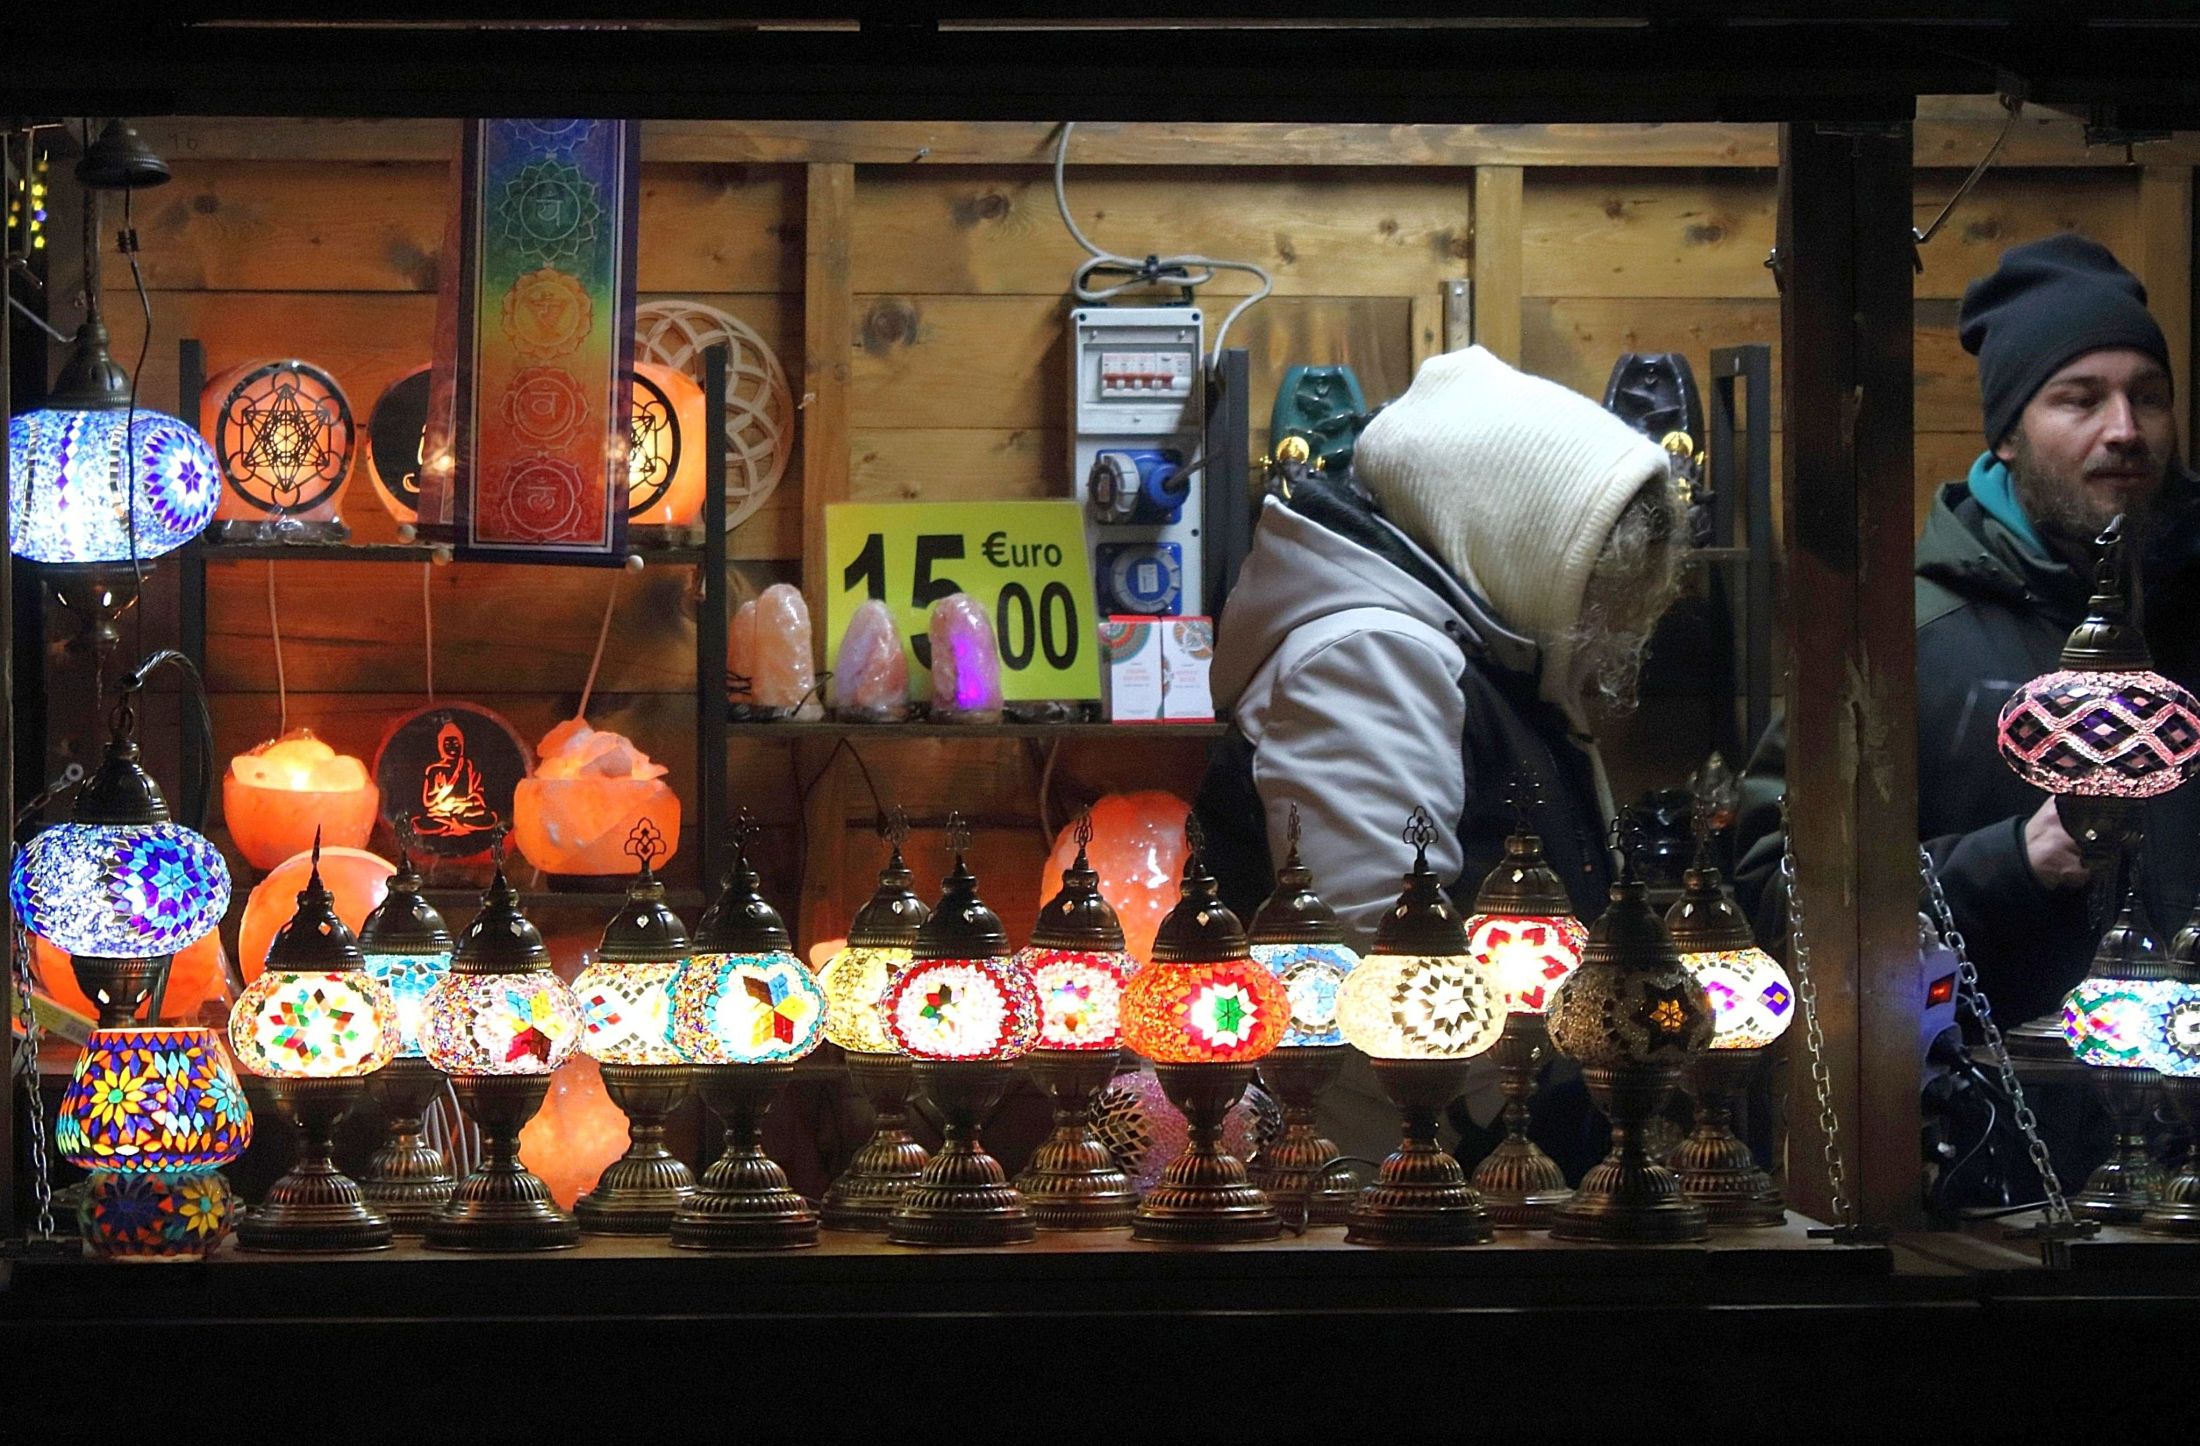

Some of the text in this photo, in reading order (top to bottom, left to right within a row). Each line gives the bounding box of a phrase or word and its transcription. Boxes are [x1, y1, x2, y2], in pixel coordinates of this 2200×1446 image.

[982, 531, 1063, 568] €uro
[844, 533, 966, 672] 15
[996, 581, 1079, 671] 00
